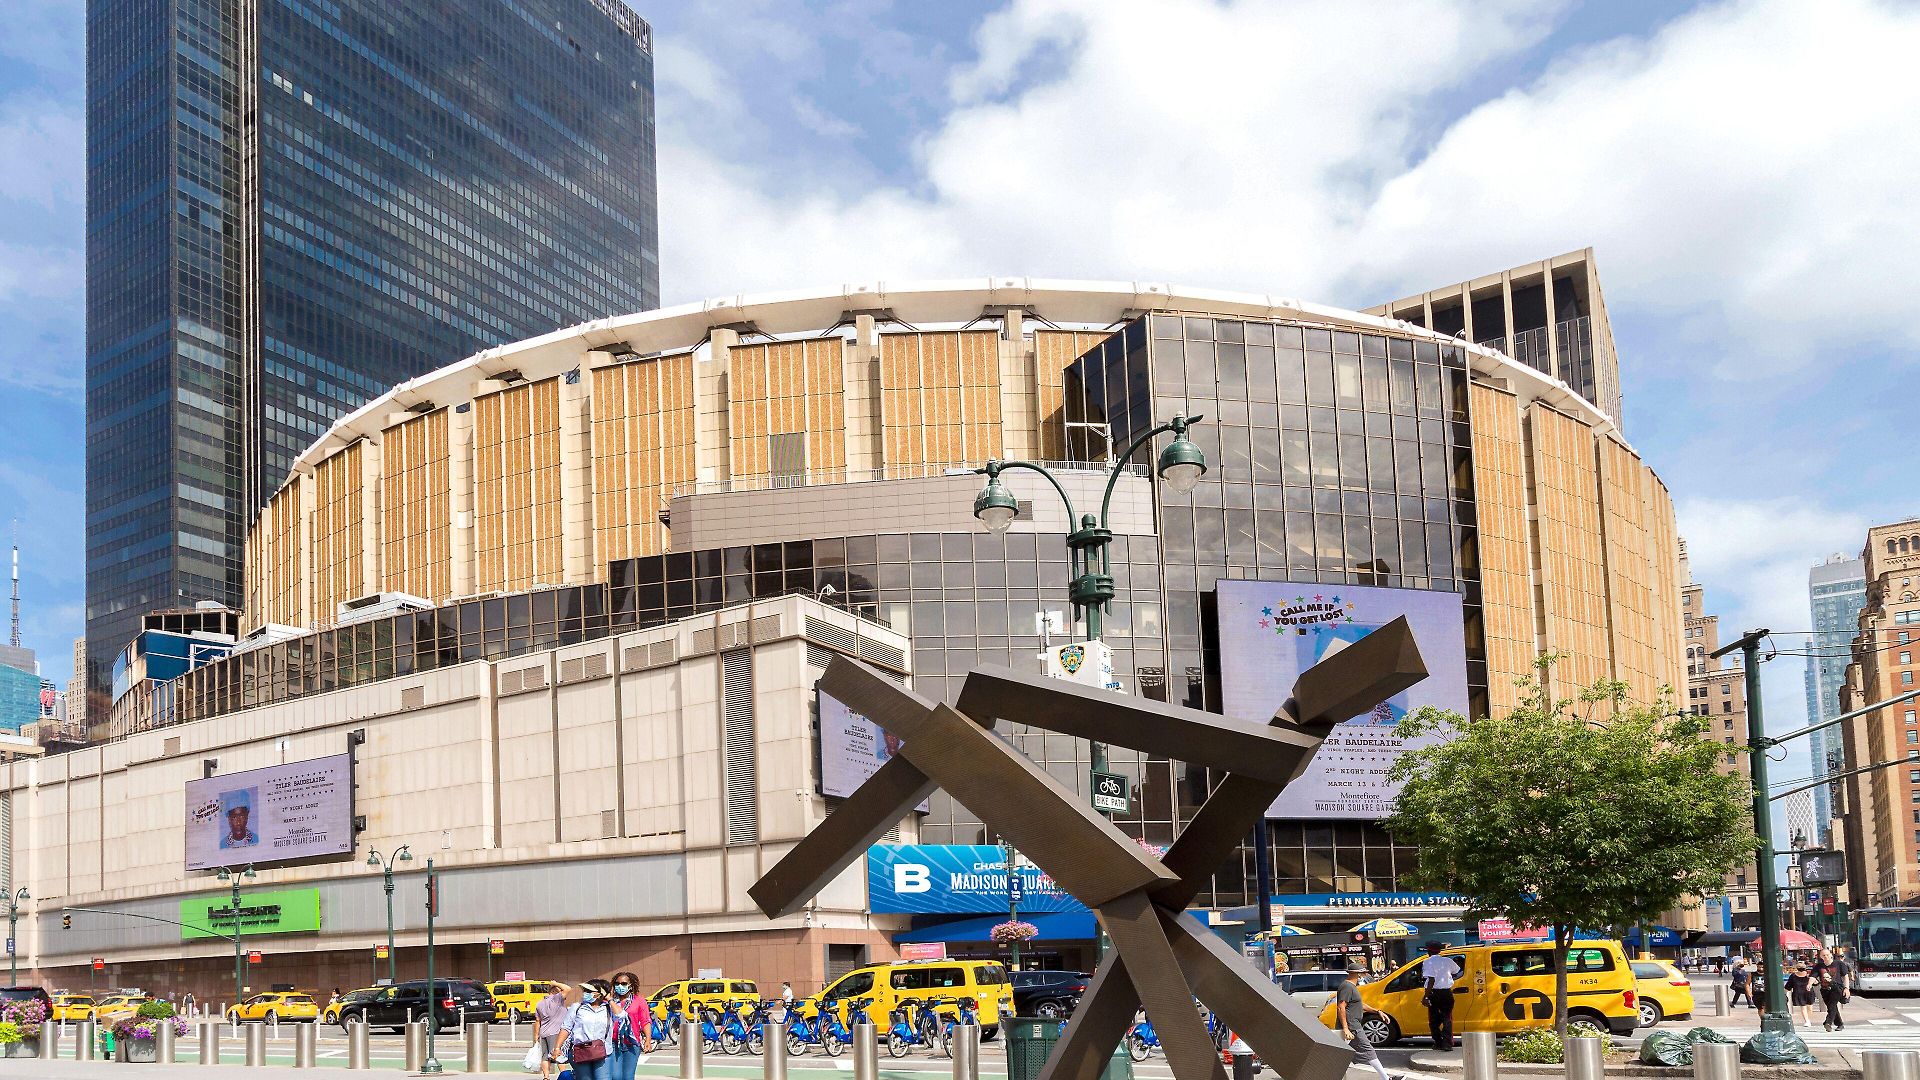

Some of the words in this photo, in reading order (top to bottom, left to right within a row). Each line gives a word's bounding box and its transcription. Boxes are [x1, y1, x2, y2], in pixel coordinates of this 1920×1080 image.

[1274, 617, 1297, 625] YOU
[1300, 615, 1318, 625] GET
[1320, 609, 1344, 621] LOST
[1280, 605, 1305, 617] CALL
[1307, 604, 1323, 612] ME
[1325, 603, 1335, 611] IF
[1345, 739, 1402, 747] BAUDELAIRE
[1096, 796, 1108, 806] BIKE
[1111, 798, 1125, 807] PATH
[1315, 803, 1345, 811] MADISON
[1347, 803, 1374, 811] SQUARE
[893, 864, 931, 893] B
[950, 872, 1008, 890] MADISON
[1329, 897, 1424, 905] PENNSYLVANIA
[1513, 997, 1541, 1020] T
